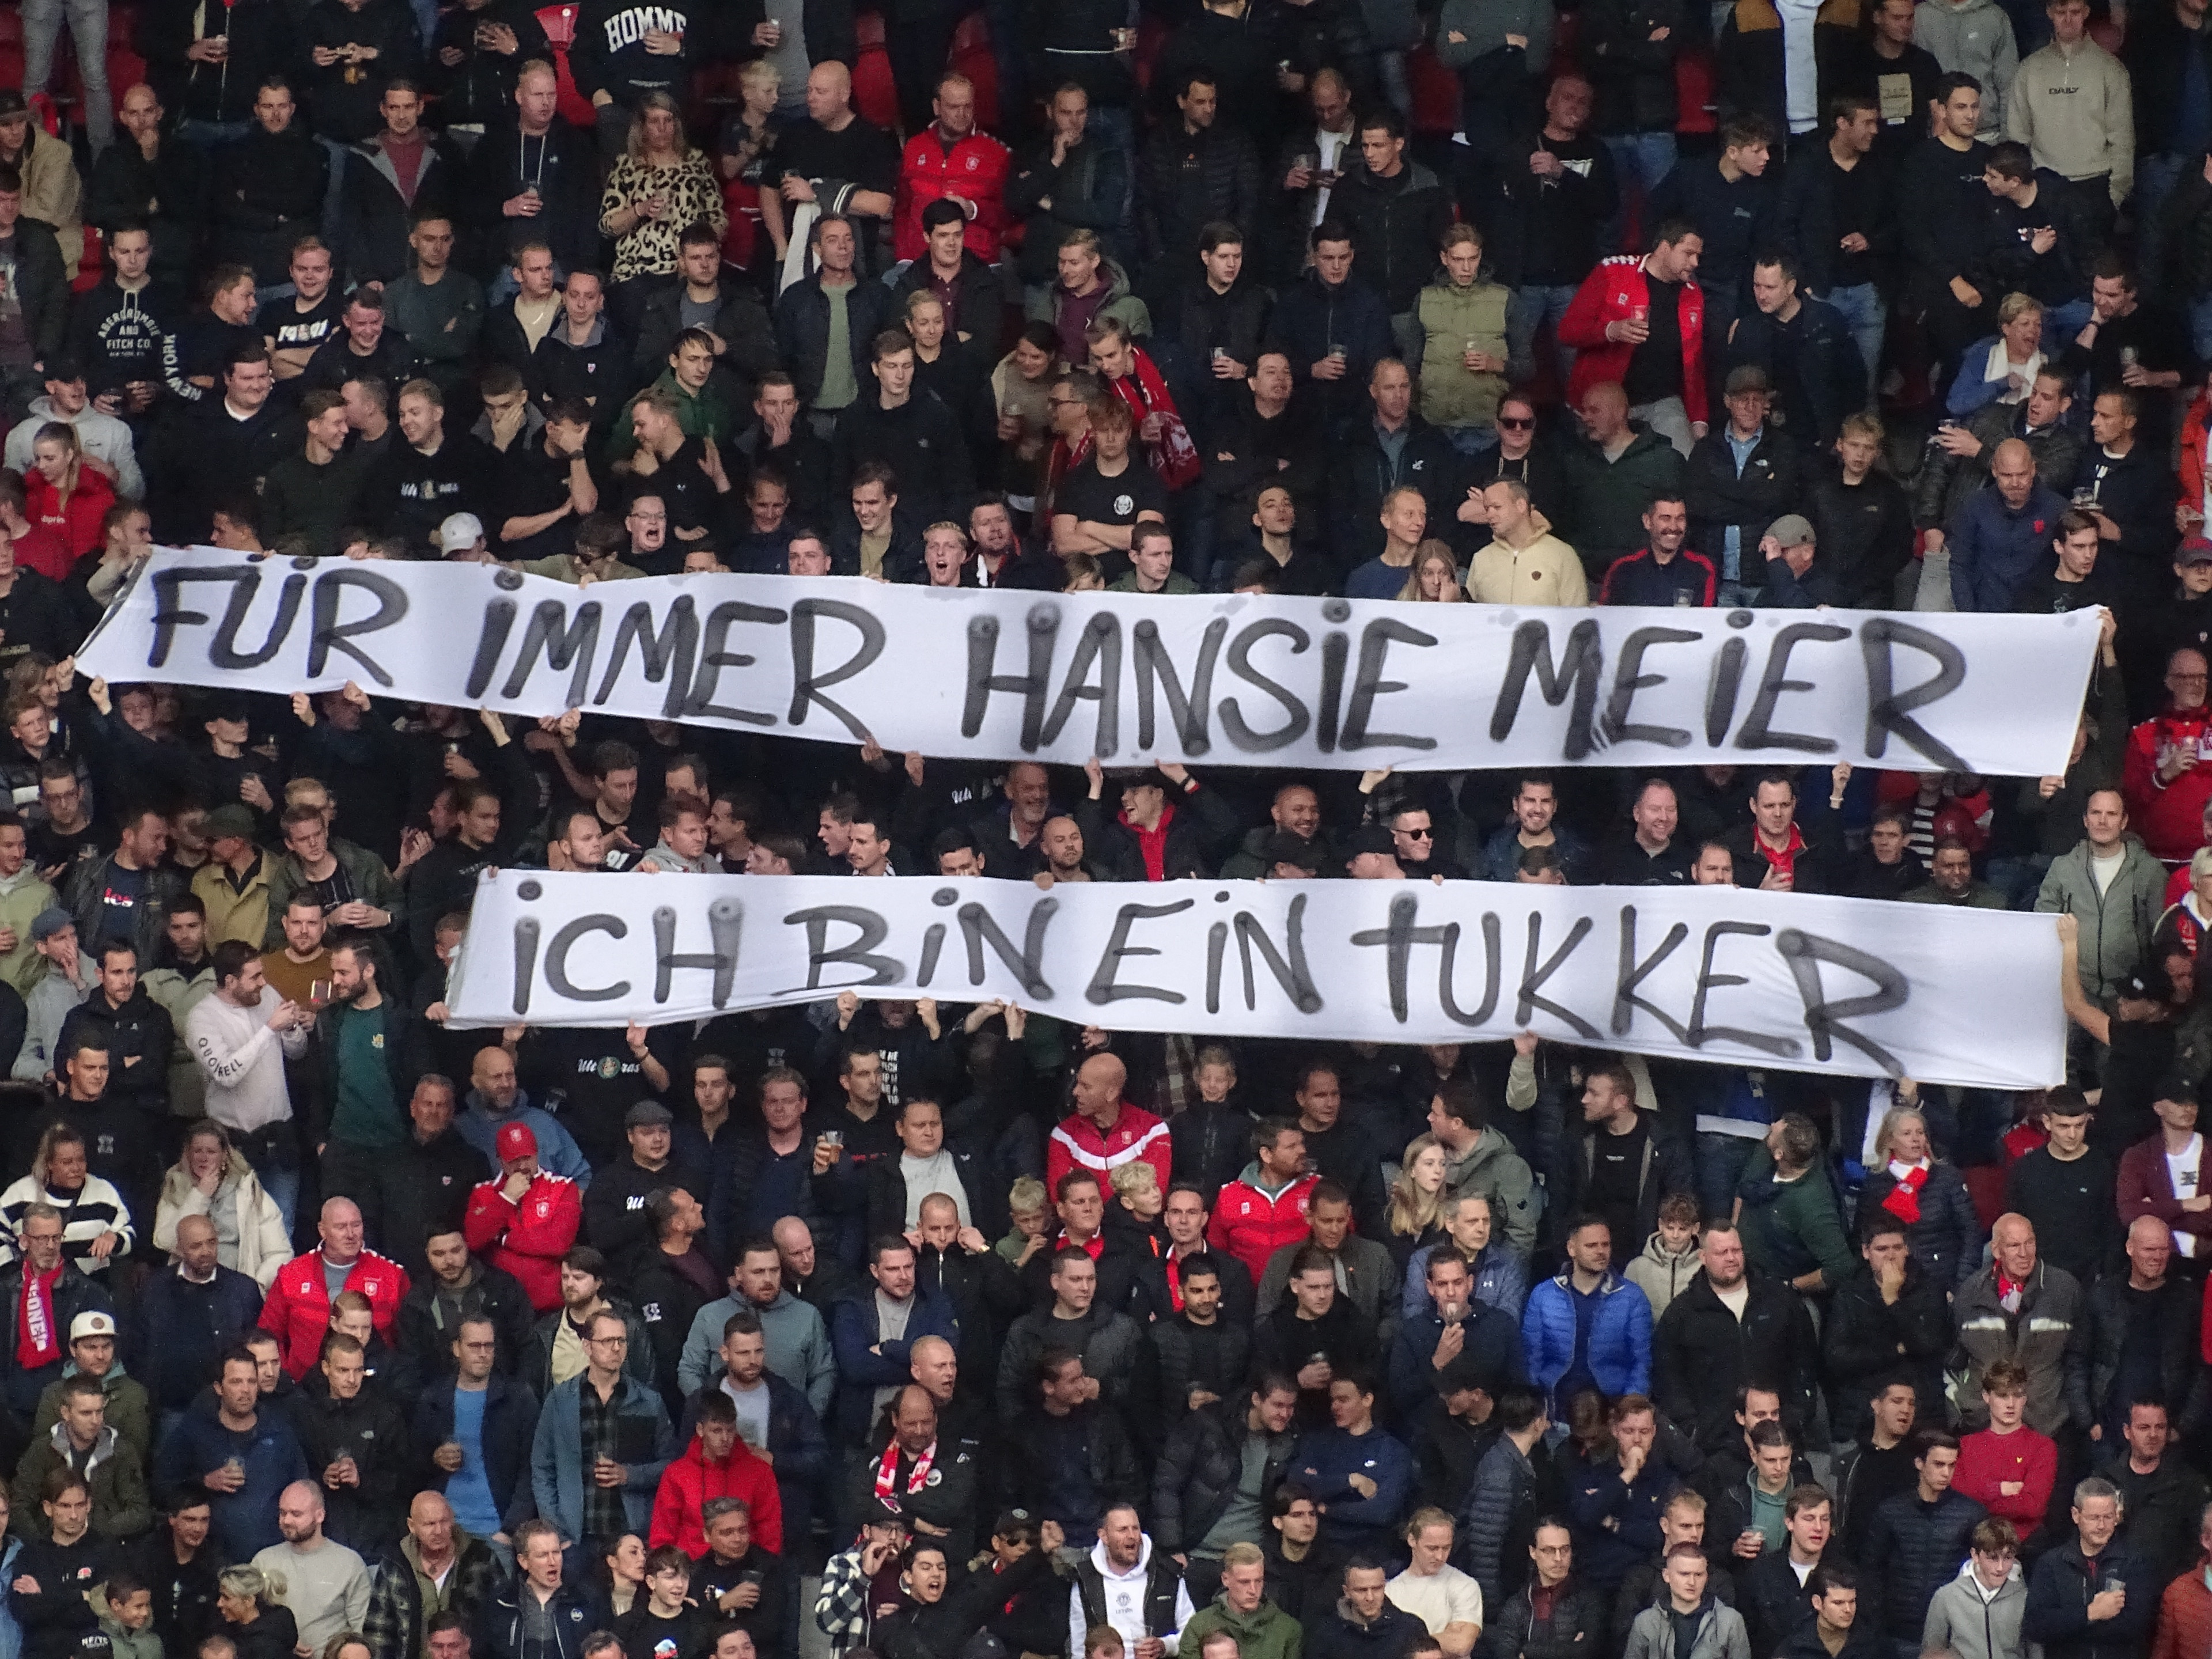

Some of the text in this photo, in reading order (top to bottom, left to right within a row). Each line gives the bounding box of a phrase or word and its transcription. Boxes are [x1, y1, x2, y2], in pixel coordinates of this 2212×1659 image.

[604, 6, 687, 53] HOMME
[119, 325, 139, 335] AND
[162, 333, 202, 402] NEW YORK
[147, 555, 409, 688] FÜR
